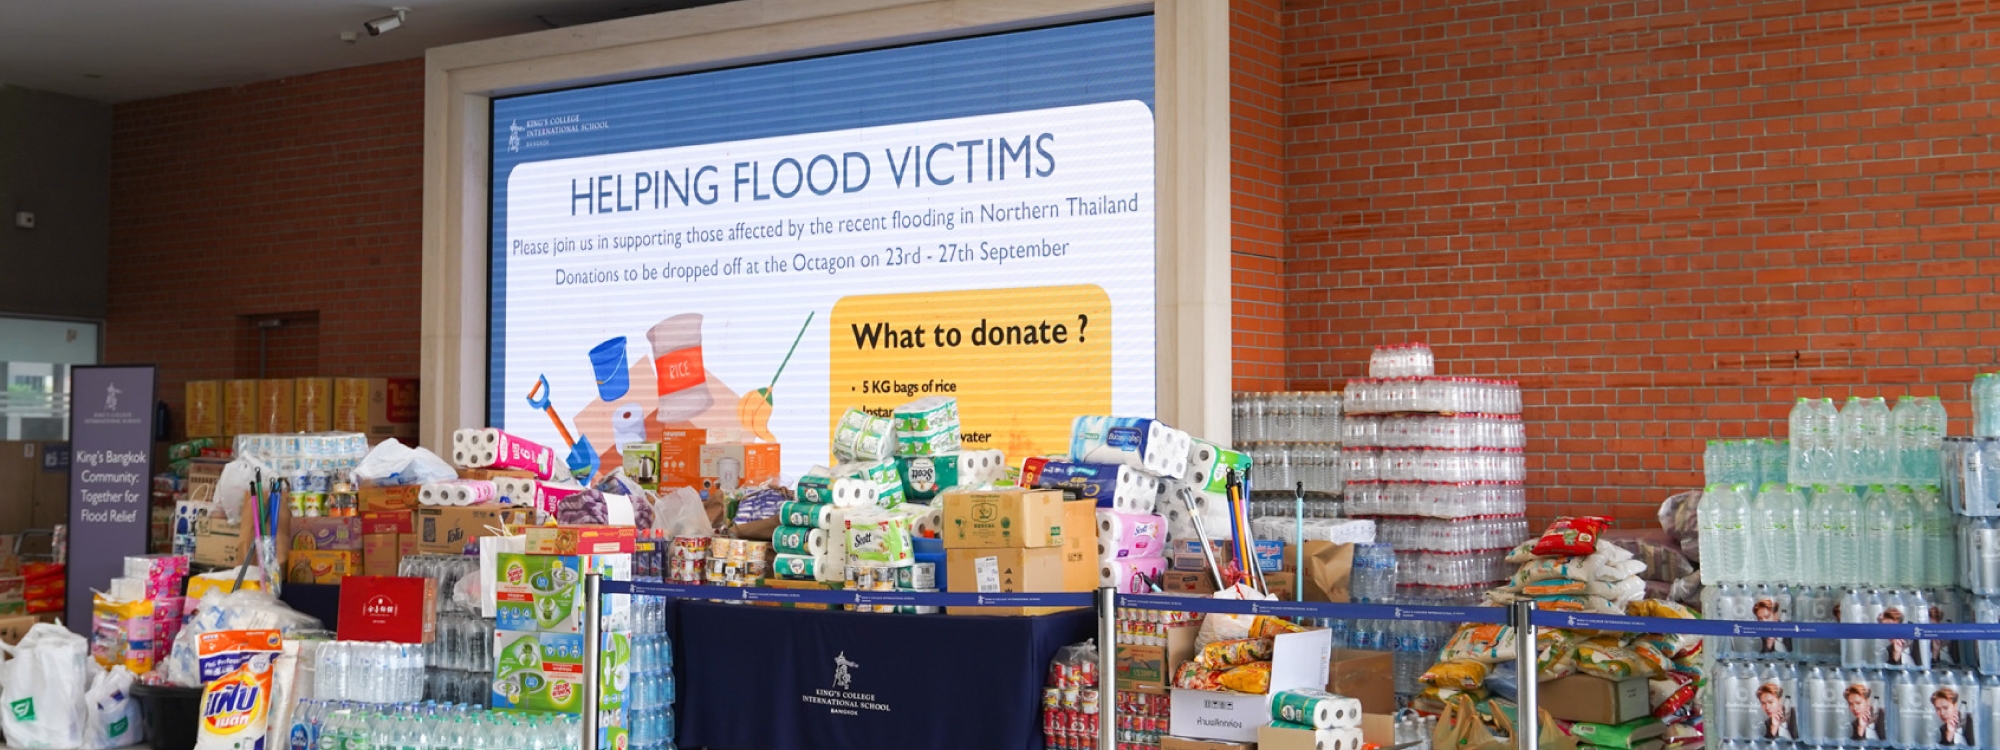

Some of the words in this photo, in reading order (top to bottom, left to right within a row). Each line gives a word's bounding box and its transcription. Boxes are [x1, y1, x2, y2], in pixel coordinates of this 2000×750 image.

[526, 119, 548, 128] KING'S
[550, 114, 580, 126] COLLEGE
[526, 124, 579, 137] INTERNATIONAL
[581, 121, 609, 131] SCHOOL
[572, 165, 719, 216] HELPING
[734, 151, 871, 202] FLOOD
[885, 133, 1055, 189] VICTIMS
[512, 239, 549, 255] Please
[553, 237, 575, 256] join
[580, 238, 593, 251] us
[597, 234, 609, 250] in
[613, 230, 682, 252] supporting
[686, 225, 723, 244] those
[728, 219, 783, 241] affected
[788, 219, 804, 241] by
[810, 217, 833, 235] the
[838, 215, 887, 232] recent
[892, 208, 955, 230] flooding
[960, 207, 973, 224] in
[981, 201, 1059, 223] Northern
[1065, 192, 1138, 216] Thailand
[555, 268, 619, 286] Donations
[624, 267, 637, 281] to
[642, 263, 657, 281] be
[662, 259, 718, 283] dropped
[723, 257, 742, 276] off
[746, 260, 759, 274] at
[765, 255, 787, 273] the
[792, 253, 855, 275] Octagon
[860, 253, 880, 268] on
[886, 246, 921, 266] 23rd
[938, 243, 974, 263] 27th
[980, 238, 1070, 265] September
[851, 322, 925, 350] What
[934, 324, 962, 347] to
[971, 318, 1068, 346] donate
[1077, 313, 1088, 343] ?
[669, 360, 690, 379] RICE
[862, 380, 869, 393] 5
[872, 380, 891, 393] KG
[893, 380, 919, 397] bags
[921, 379, 934, 393] of
[935, 379, 957, 393] rice
[76, 450, 104, 466] King's
[106, 450, 146, 466] Bangkok
[81, 469, 139, 485] Community:
[81, 489, 123, 506] Together
[124, 489, 139, 503] for
[81, 509, 108, 523] Flood
[109, 509, 137, 523] Relief
[854, 532, 871, 548] Scott
[816, 688, 841, 698] KING'S
[842, 691, 875, 701] COLLEGE
[802, 695, 859, 708] INTERNATIONAL
[860, 702, 891, 712] SCHOOL
[830, 708, 858, 716] BANGKOK
